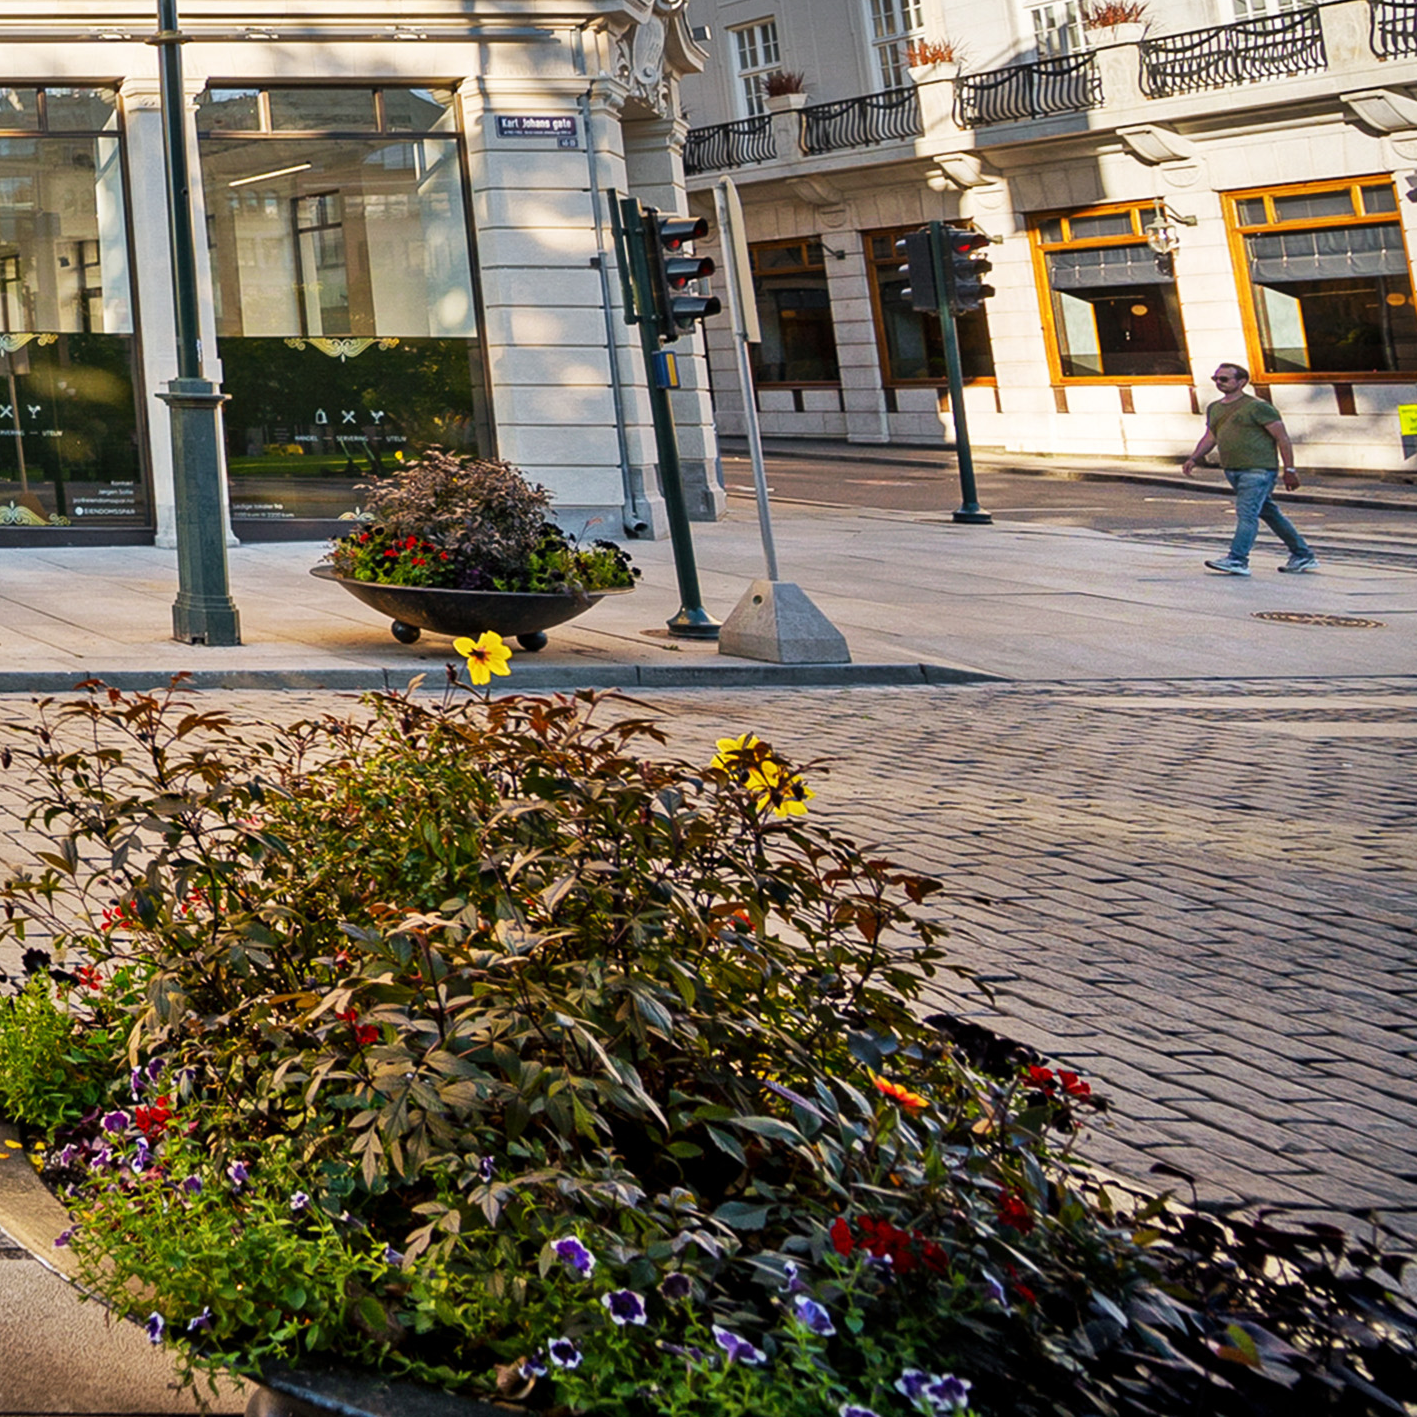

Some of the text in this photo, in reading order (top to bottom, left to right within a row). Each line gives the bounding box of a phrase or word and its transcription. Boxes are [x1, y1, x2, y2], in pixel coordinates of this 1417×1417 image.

[501, 118, 571, 131] Karl Johans gate
